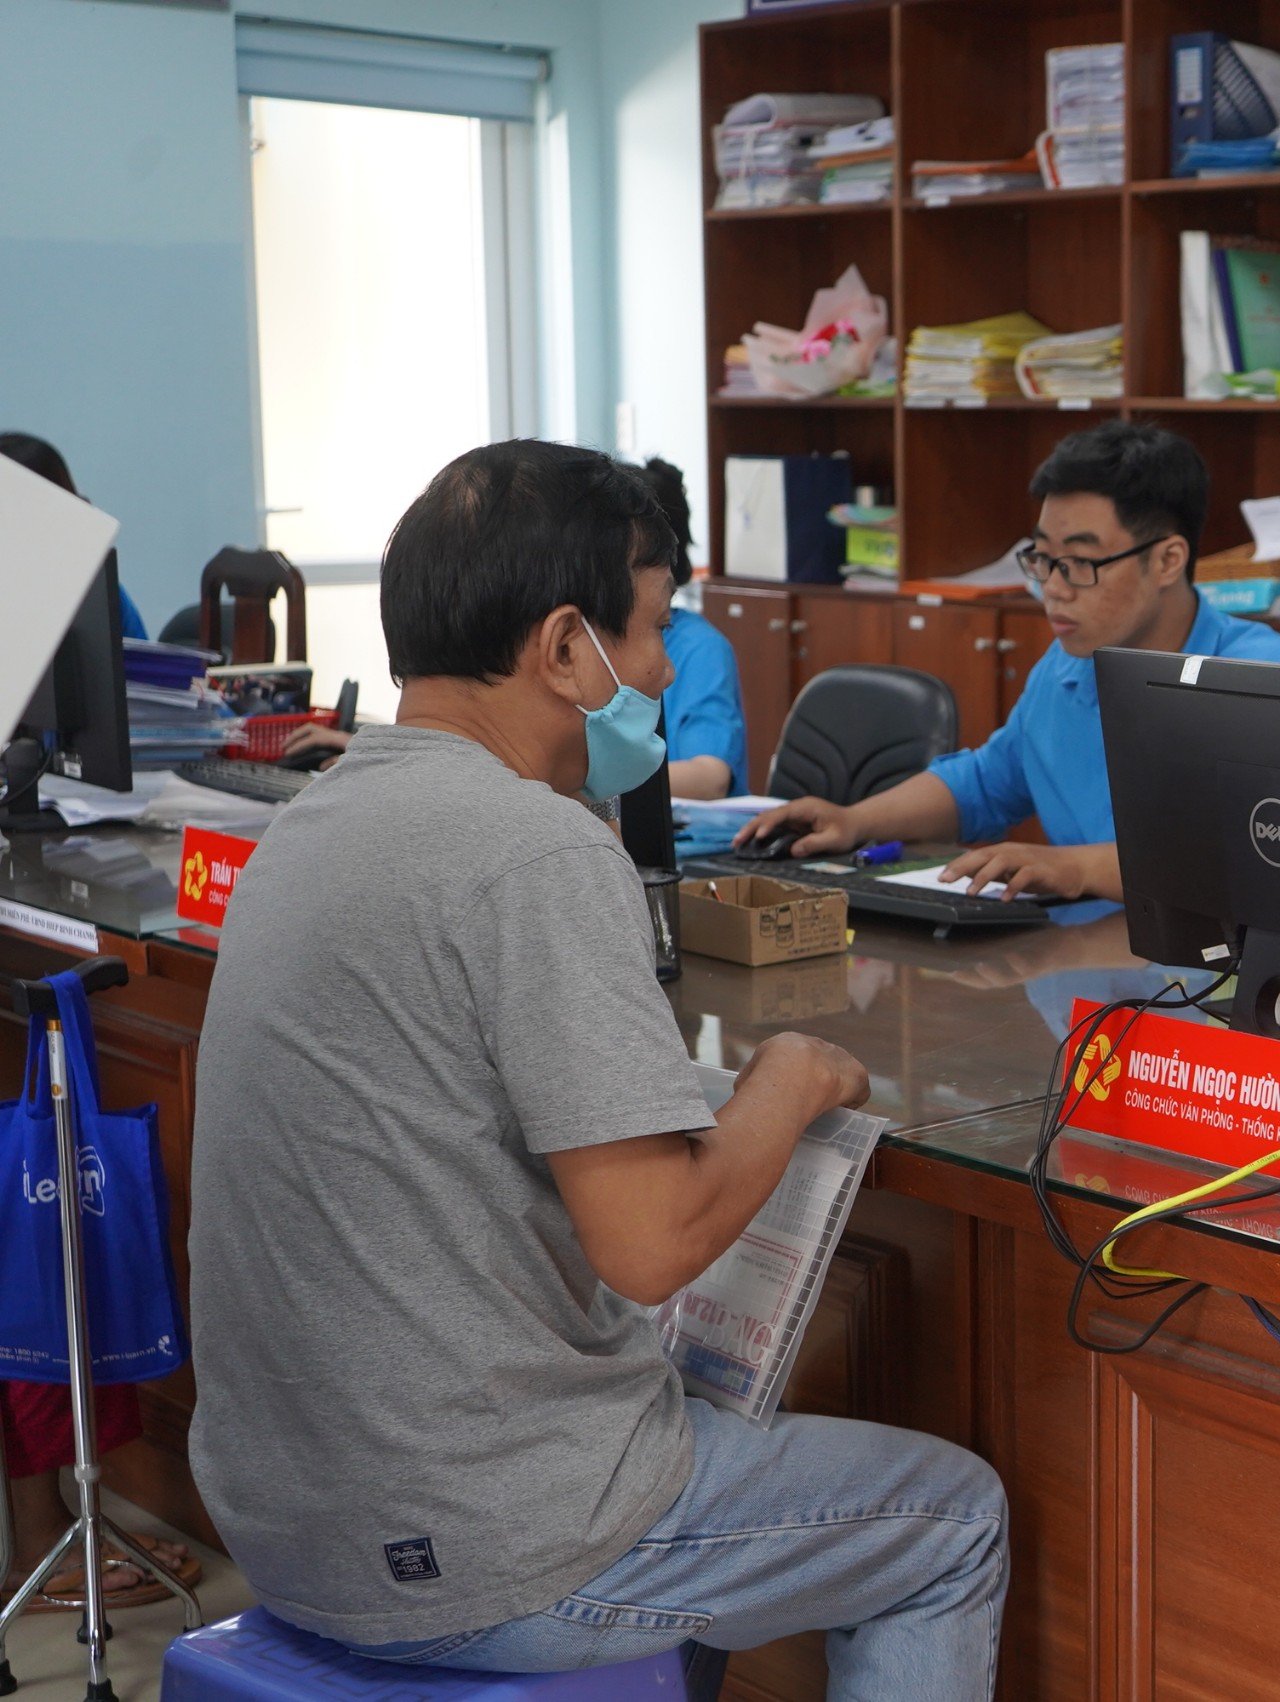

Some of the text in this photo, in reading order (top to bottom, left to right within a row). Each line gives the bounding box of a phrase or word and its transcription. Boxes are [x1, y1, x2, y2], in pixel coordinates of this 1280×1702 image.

[1127, 1049, 1191, 1091] NGUYỄN
[1192, 1064, 1237, 1105] NGỌC
[1125, 1088, 1151, 1111] CÔNG
[1152, 1095, 1179, 1117] CHỨC
[1180, 1101, 1199, 1123] VĂN
[1200, 1107, 1234, 1131] PHÒNG
[1241, 1115, 1274, 1140] THỐNG
